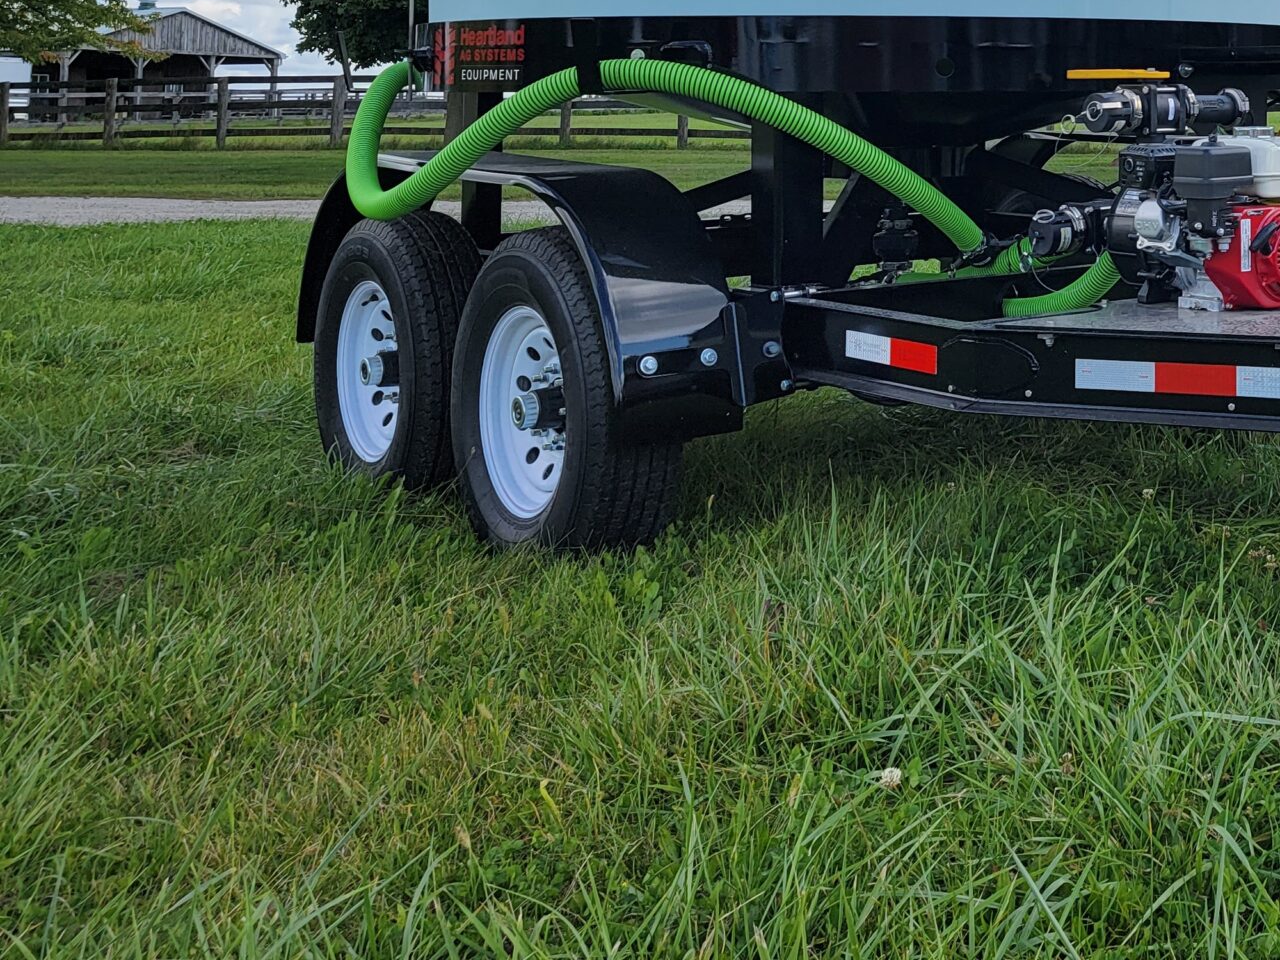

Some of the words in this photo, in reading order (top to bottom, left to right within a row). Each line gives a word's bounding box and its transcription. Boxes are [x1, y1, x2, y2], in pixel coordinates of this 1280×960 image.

[460, 23, 525, 46] Heartland
[460, 49, 472, 61] AG
[474, 48, 525, 61] SYSTEMS
[461, 69, 520, 81] EQUIPMENT
